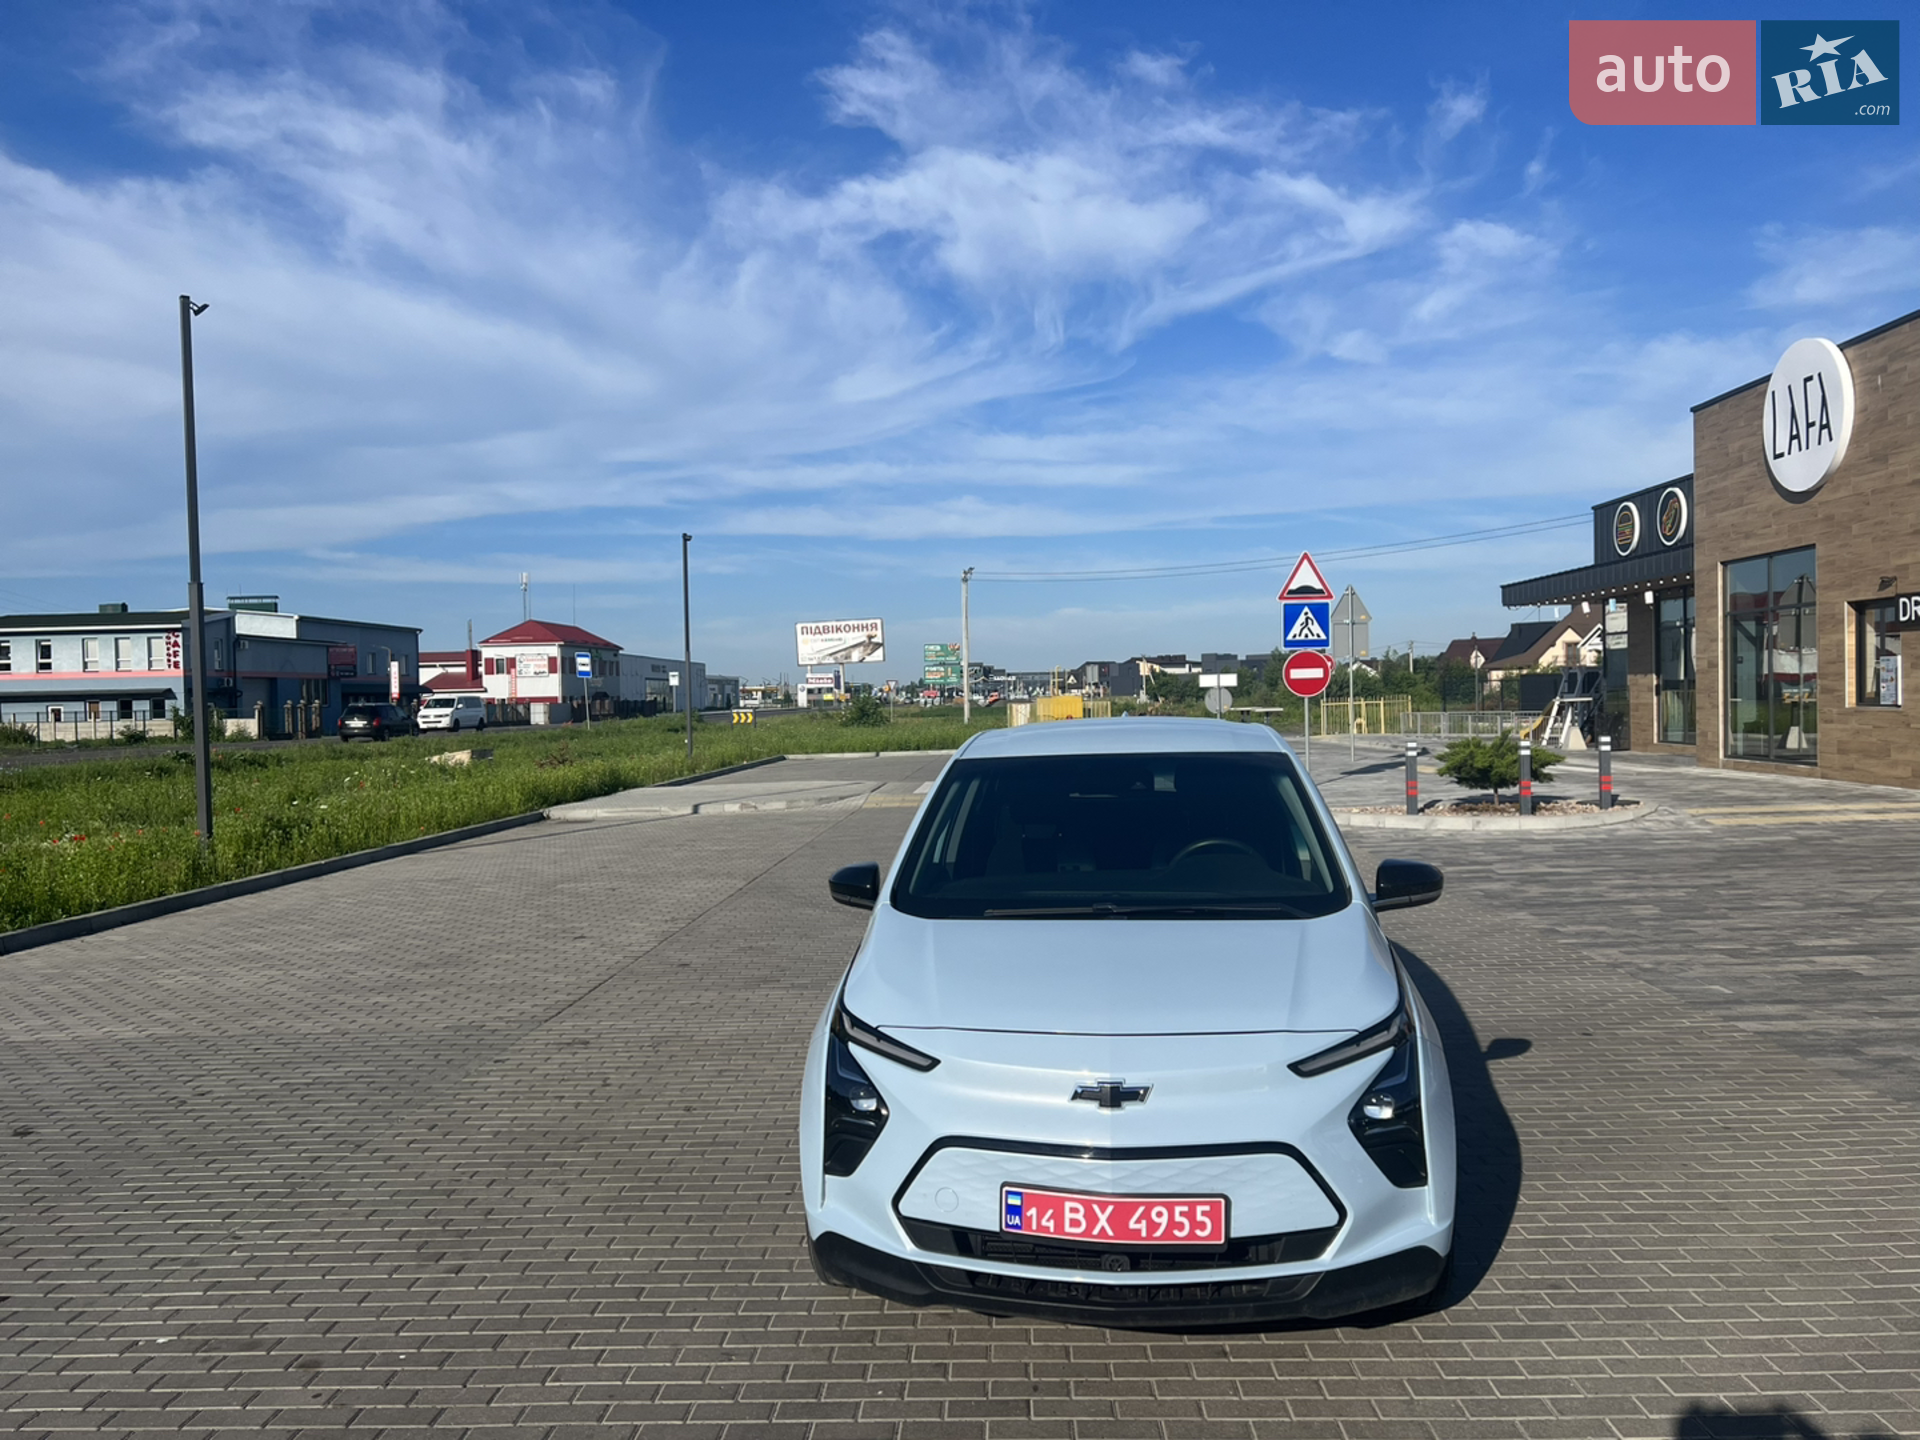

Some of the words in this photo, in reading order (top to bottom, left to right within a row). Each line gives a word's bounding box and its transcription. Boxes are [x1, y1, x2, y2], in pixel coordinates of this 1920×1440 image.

[1771, 371, 1834, 461] LAFA
[800, 622, 878, 636] ПІДВІКОННЯ
[171, 631, 181, 669] CAFE
[1007, 1214, 1022, 1227] UA
[1026, 1206, 1055, 1233] 14
[1063, 1200, 1115, 1237] BX
[1128, 1204, 1213, 1238] 4955
